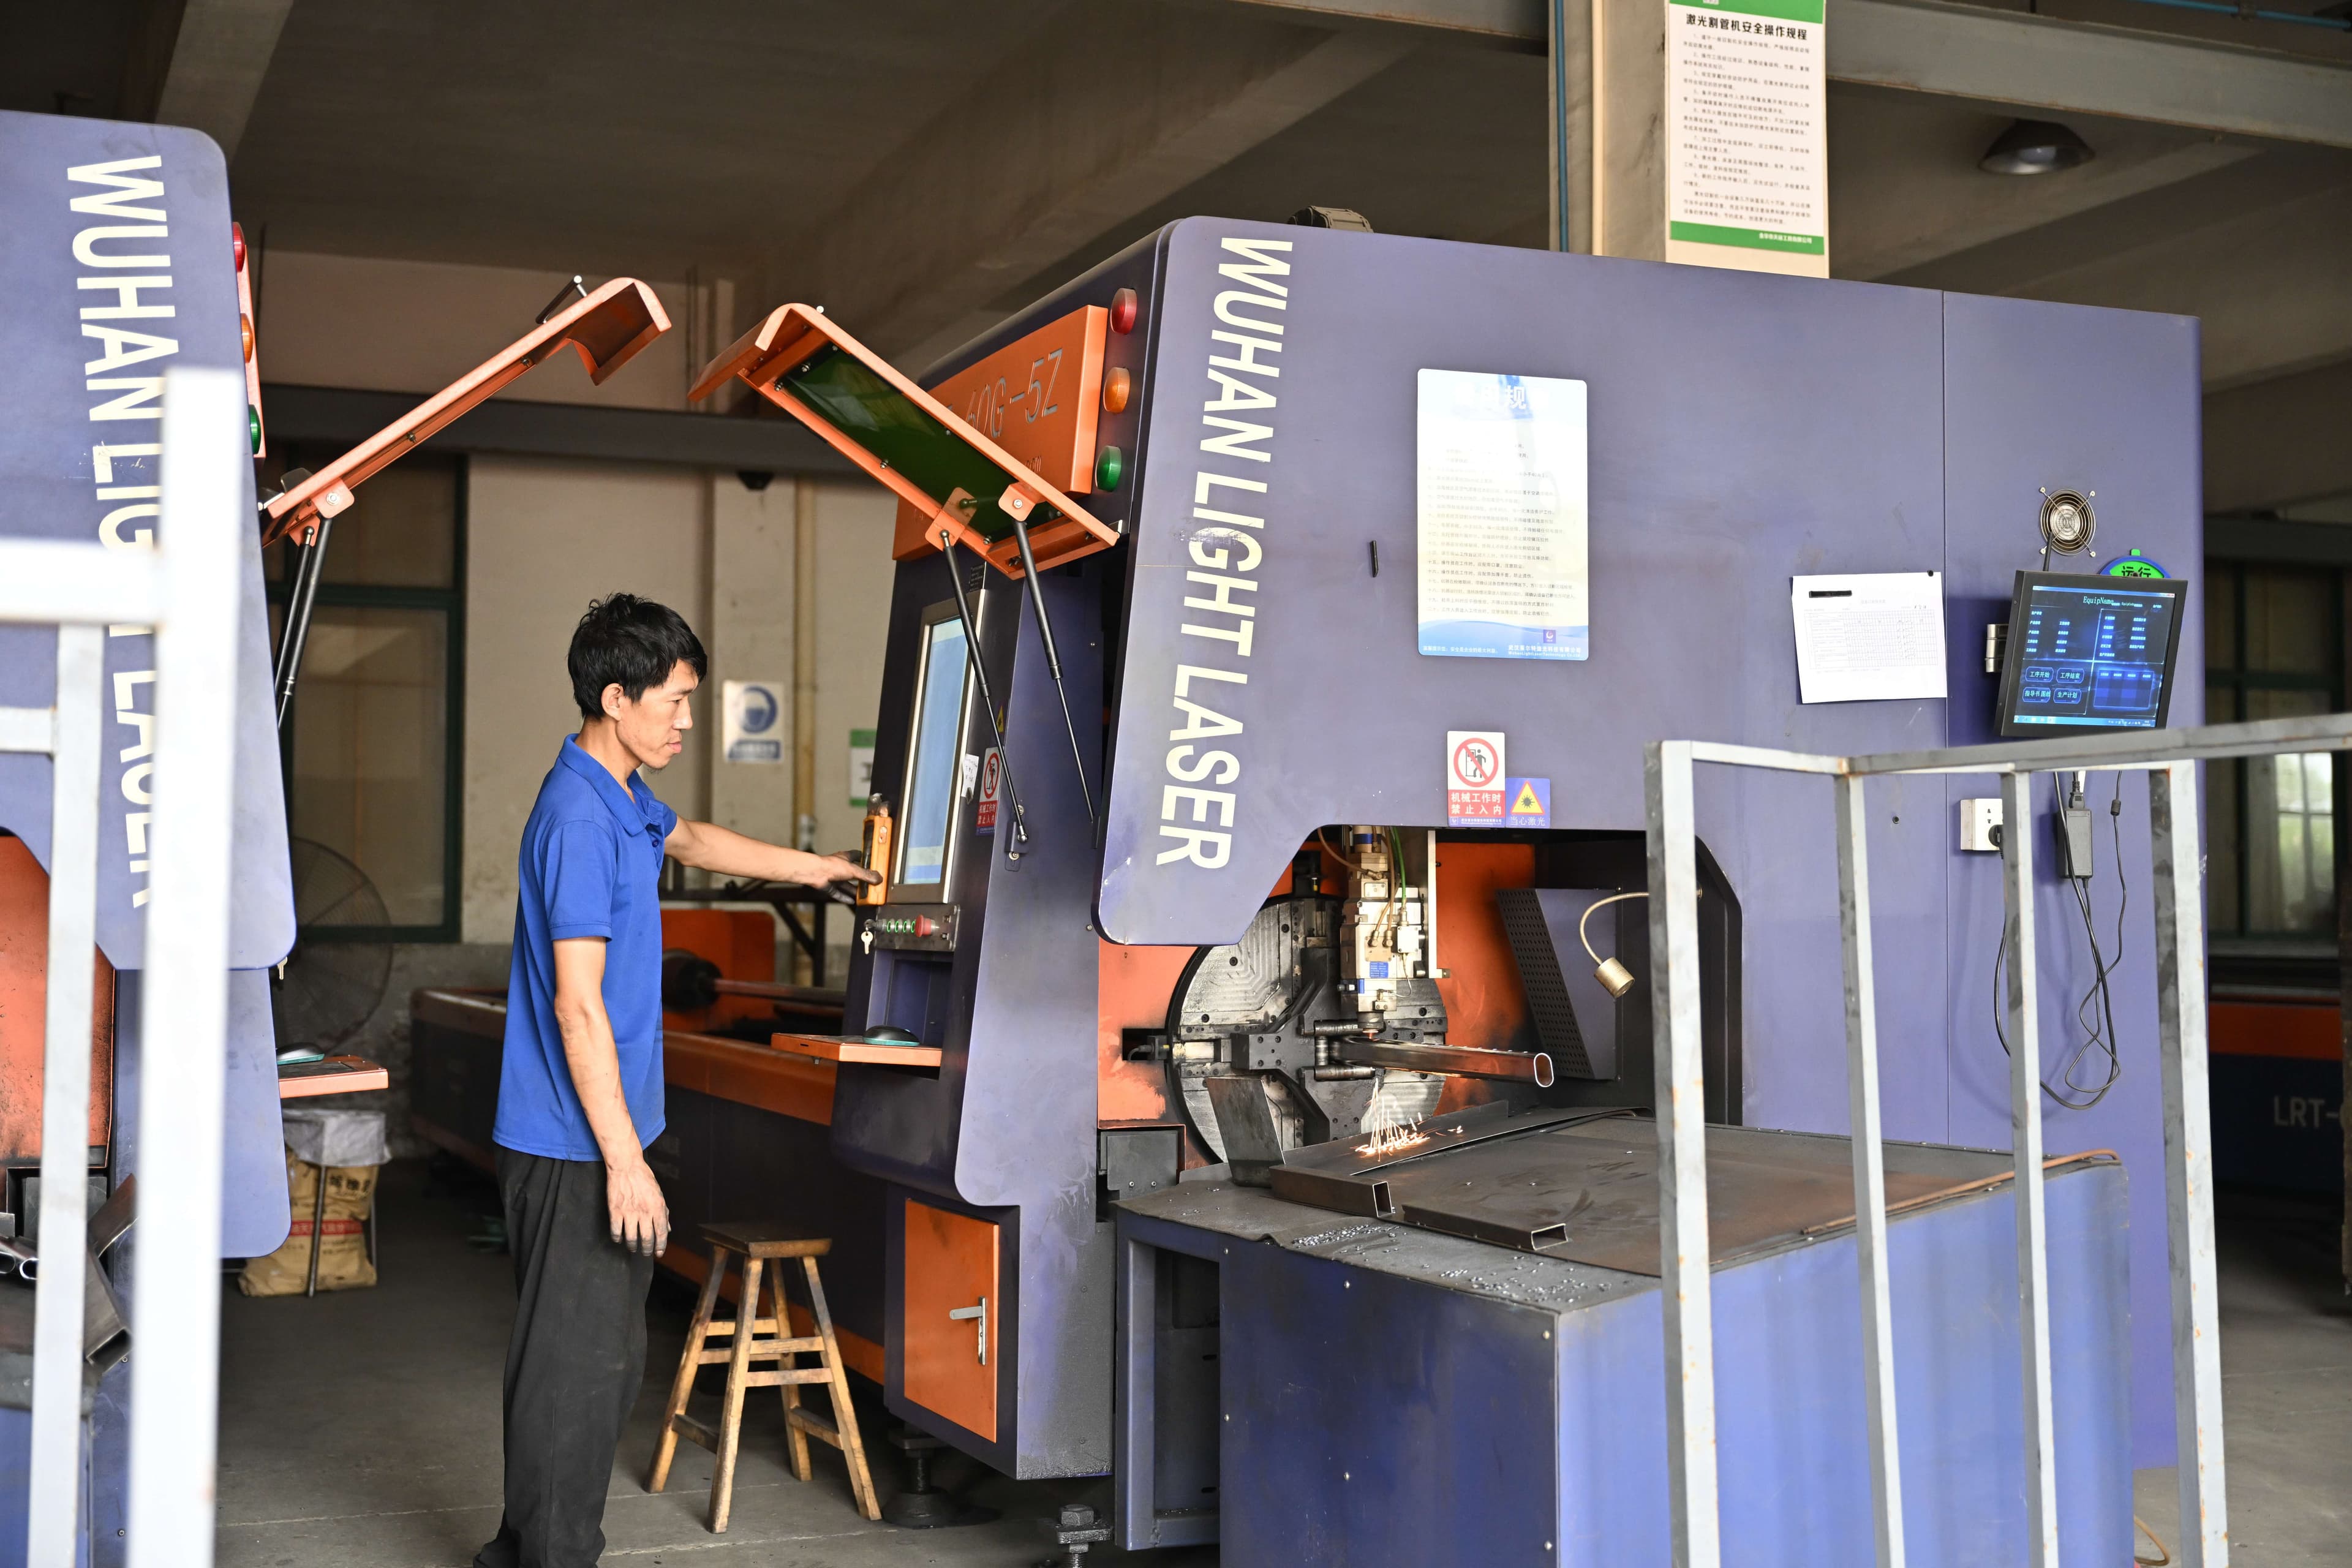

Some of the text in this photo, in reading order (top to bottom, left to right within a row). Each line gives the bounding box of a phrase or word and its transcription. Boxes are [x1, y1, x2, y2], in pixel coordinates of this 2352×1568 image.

[1686, 13, 1807, 40] 激光割管机安全操作规程
[67, 156, 179, 421] WUHAN
[947, 348, 1063, 439] 60G-5Z
[1156, 237, 1293, 869] WUHAN LIGHT LASER
[2122, 566, 2151, 578] 运行
[2083, 596, 2114, 605] EquipName
[1451, 792, 1501, 803] 机械工作时
[1451, 804, 1501, 815] 禁止入内
[1510, 815, 1545, 826] 当心激光
